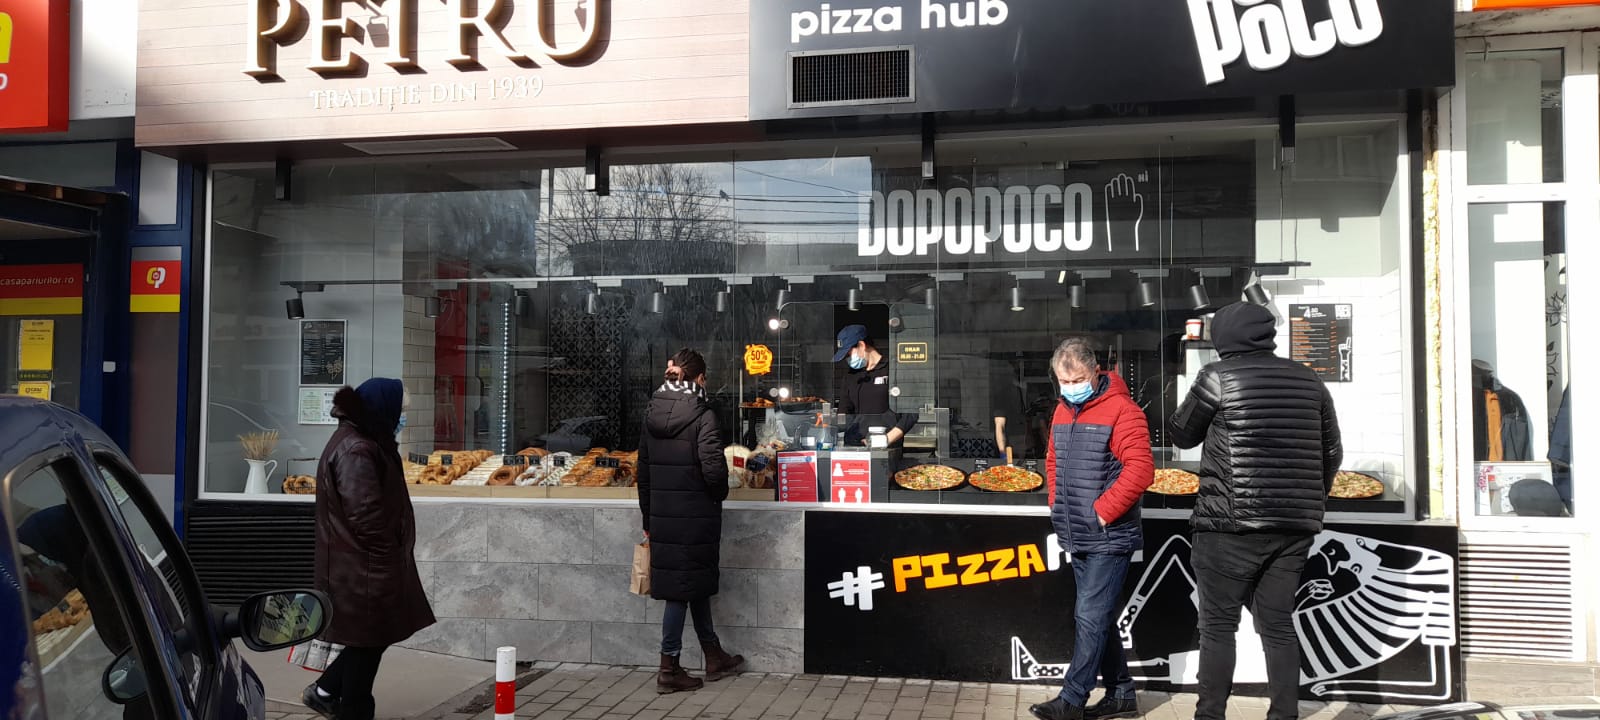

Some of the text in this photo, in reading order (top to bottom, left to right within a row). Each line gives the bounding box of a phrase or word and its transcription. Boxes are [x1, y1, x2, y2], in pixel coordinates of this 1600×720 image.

[790, 0, 1009, 44] pizza hub
[431, 80, 478, 104] DIN
[487, 75, 544, 100] 1939
[857, 182, 1093, 256] DOPOPOCO
[0, 275, 75, 287] casapariurilor.ro
[751, 349, 768, 361] 50%
